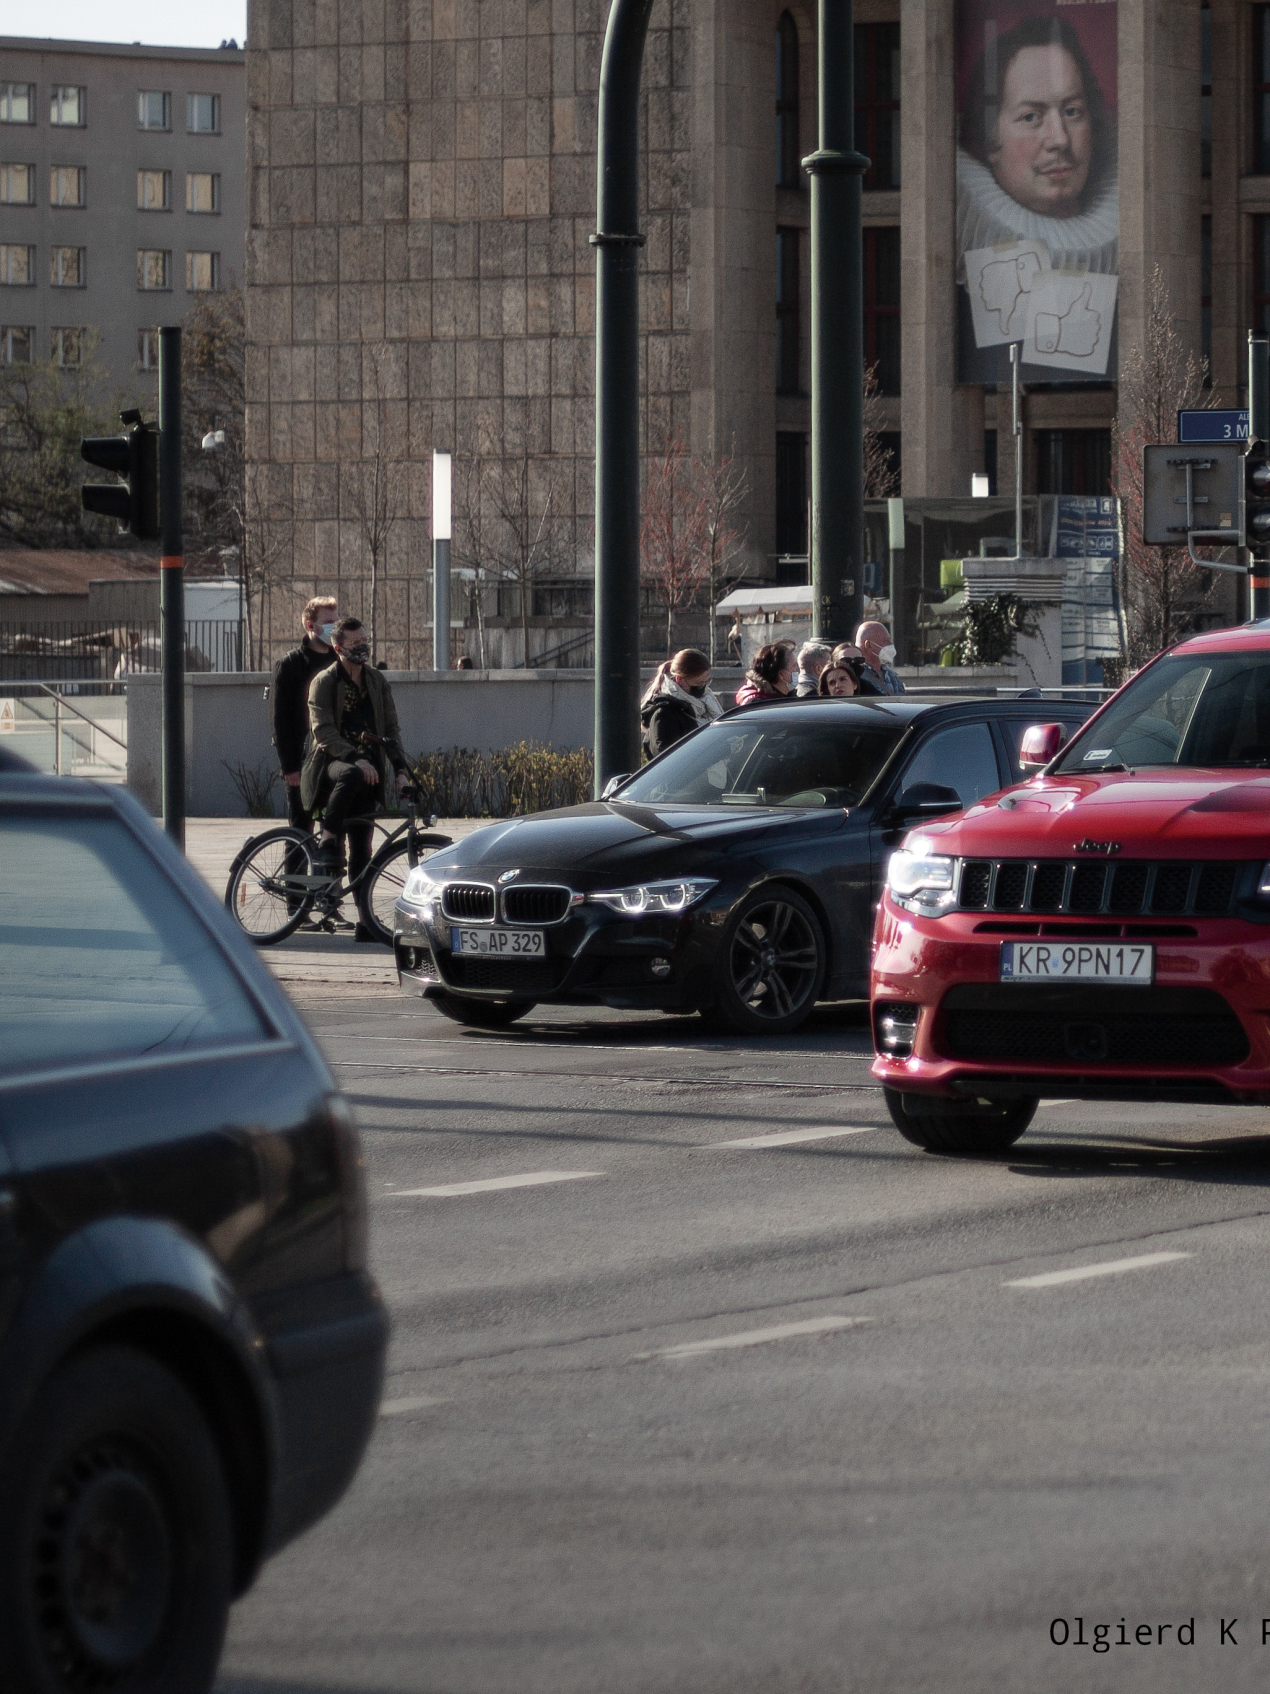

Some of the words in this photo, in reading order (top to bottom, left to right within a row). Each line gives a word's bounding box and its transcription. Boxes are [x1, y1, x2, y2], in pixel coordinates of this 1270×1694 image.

[1223, 424, 1232, 438] 3
[1073, 838, 1120, 855] Jeep
[460, 931, 478, 950] FS
[489, 933, 507, 951] AP
[512, 933, 541, 953] 329
[1019, 946, 1050, 974] KR
[1063, 946, 1145, 976] 9PN17
